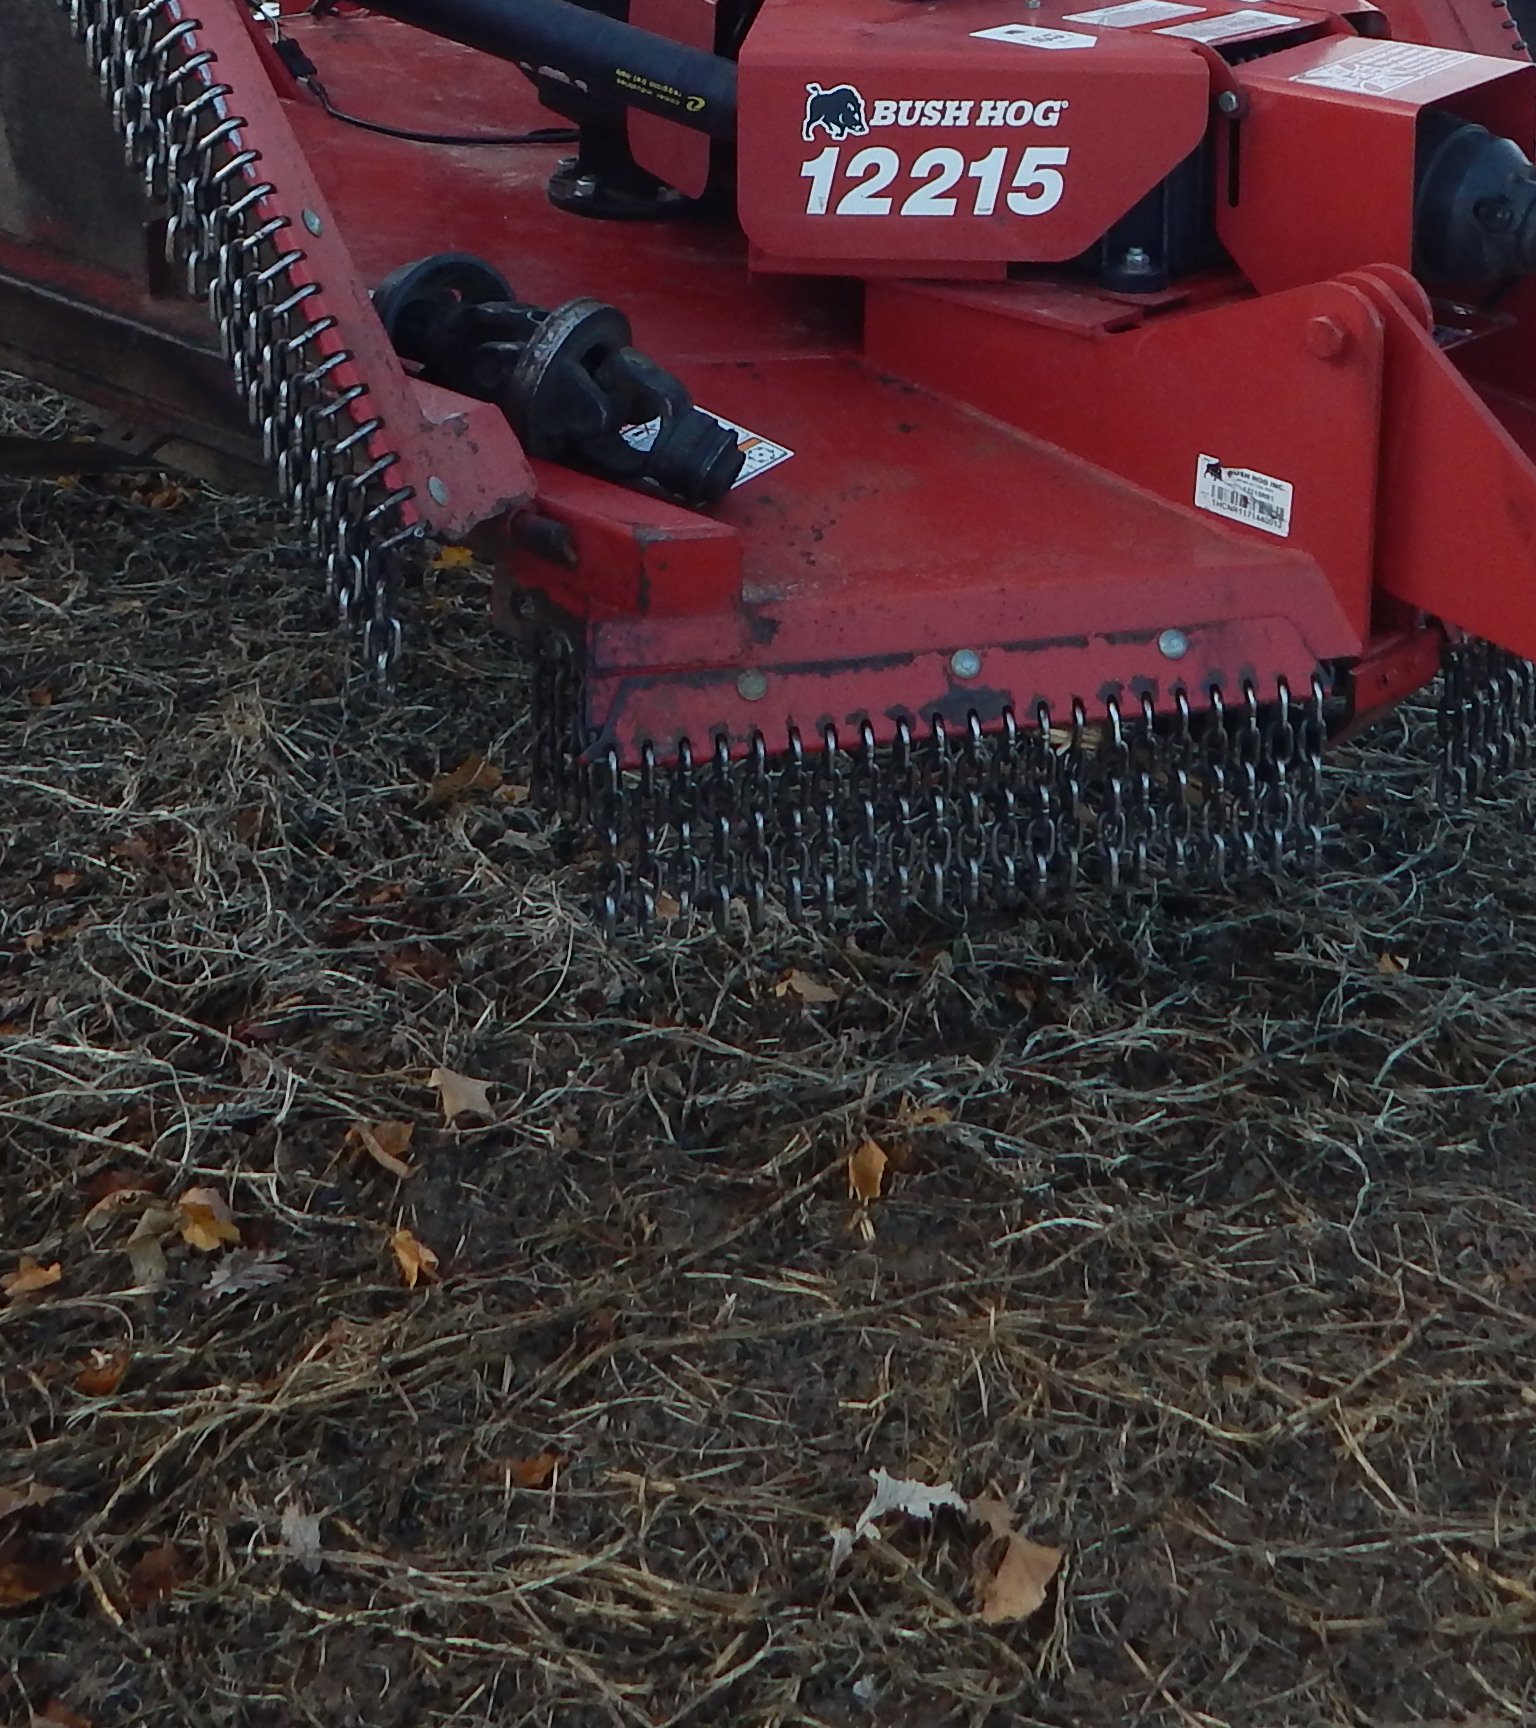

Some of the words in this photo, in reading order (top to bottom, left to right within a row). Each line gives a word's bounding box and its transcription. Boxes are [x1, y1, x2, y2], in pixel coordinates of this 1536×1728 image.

[869, 100, 974, 127] BUSH
[976, 100, 1064, 127] HOG
[800, 146, 1070, 216] 12215
[1251, 473, 1269, 486] HOG
